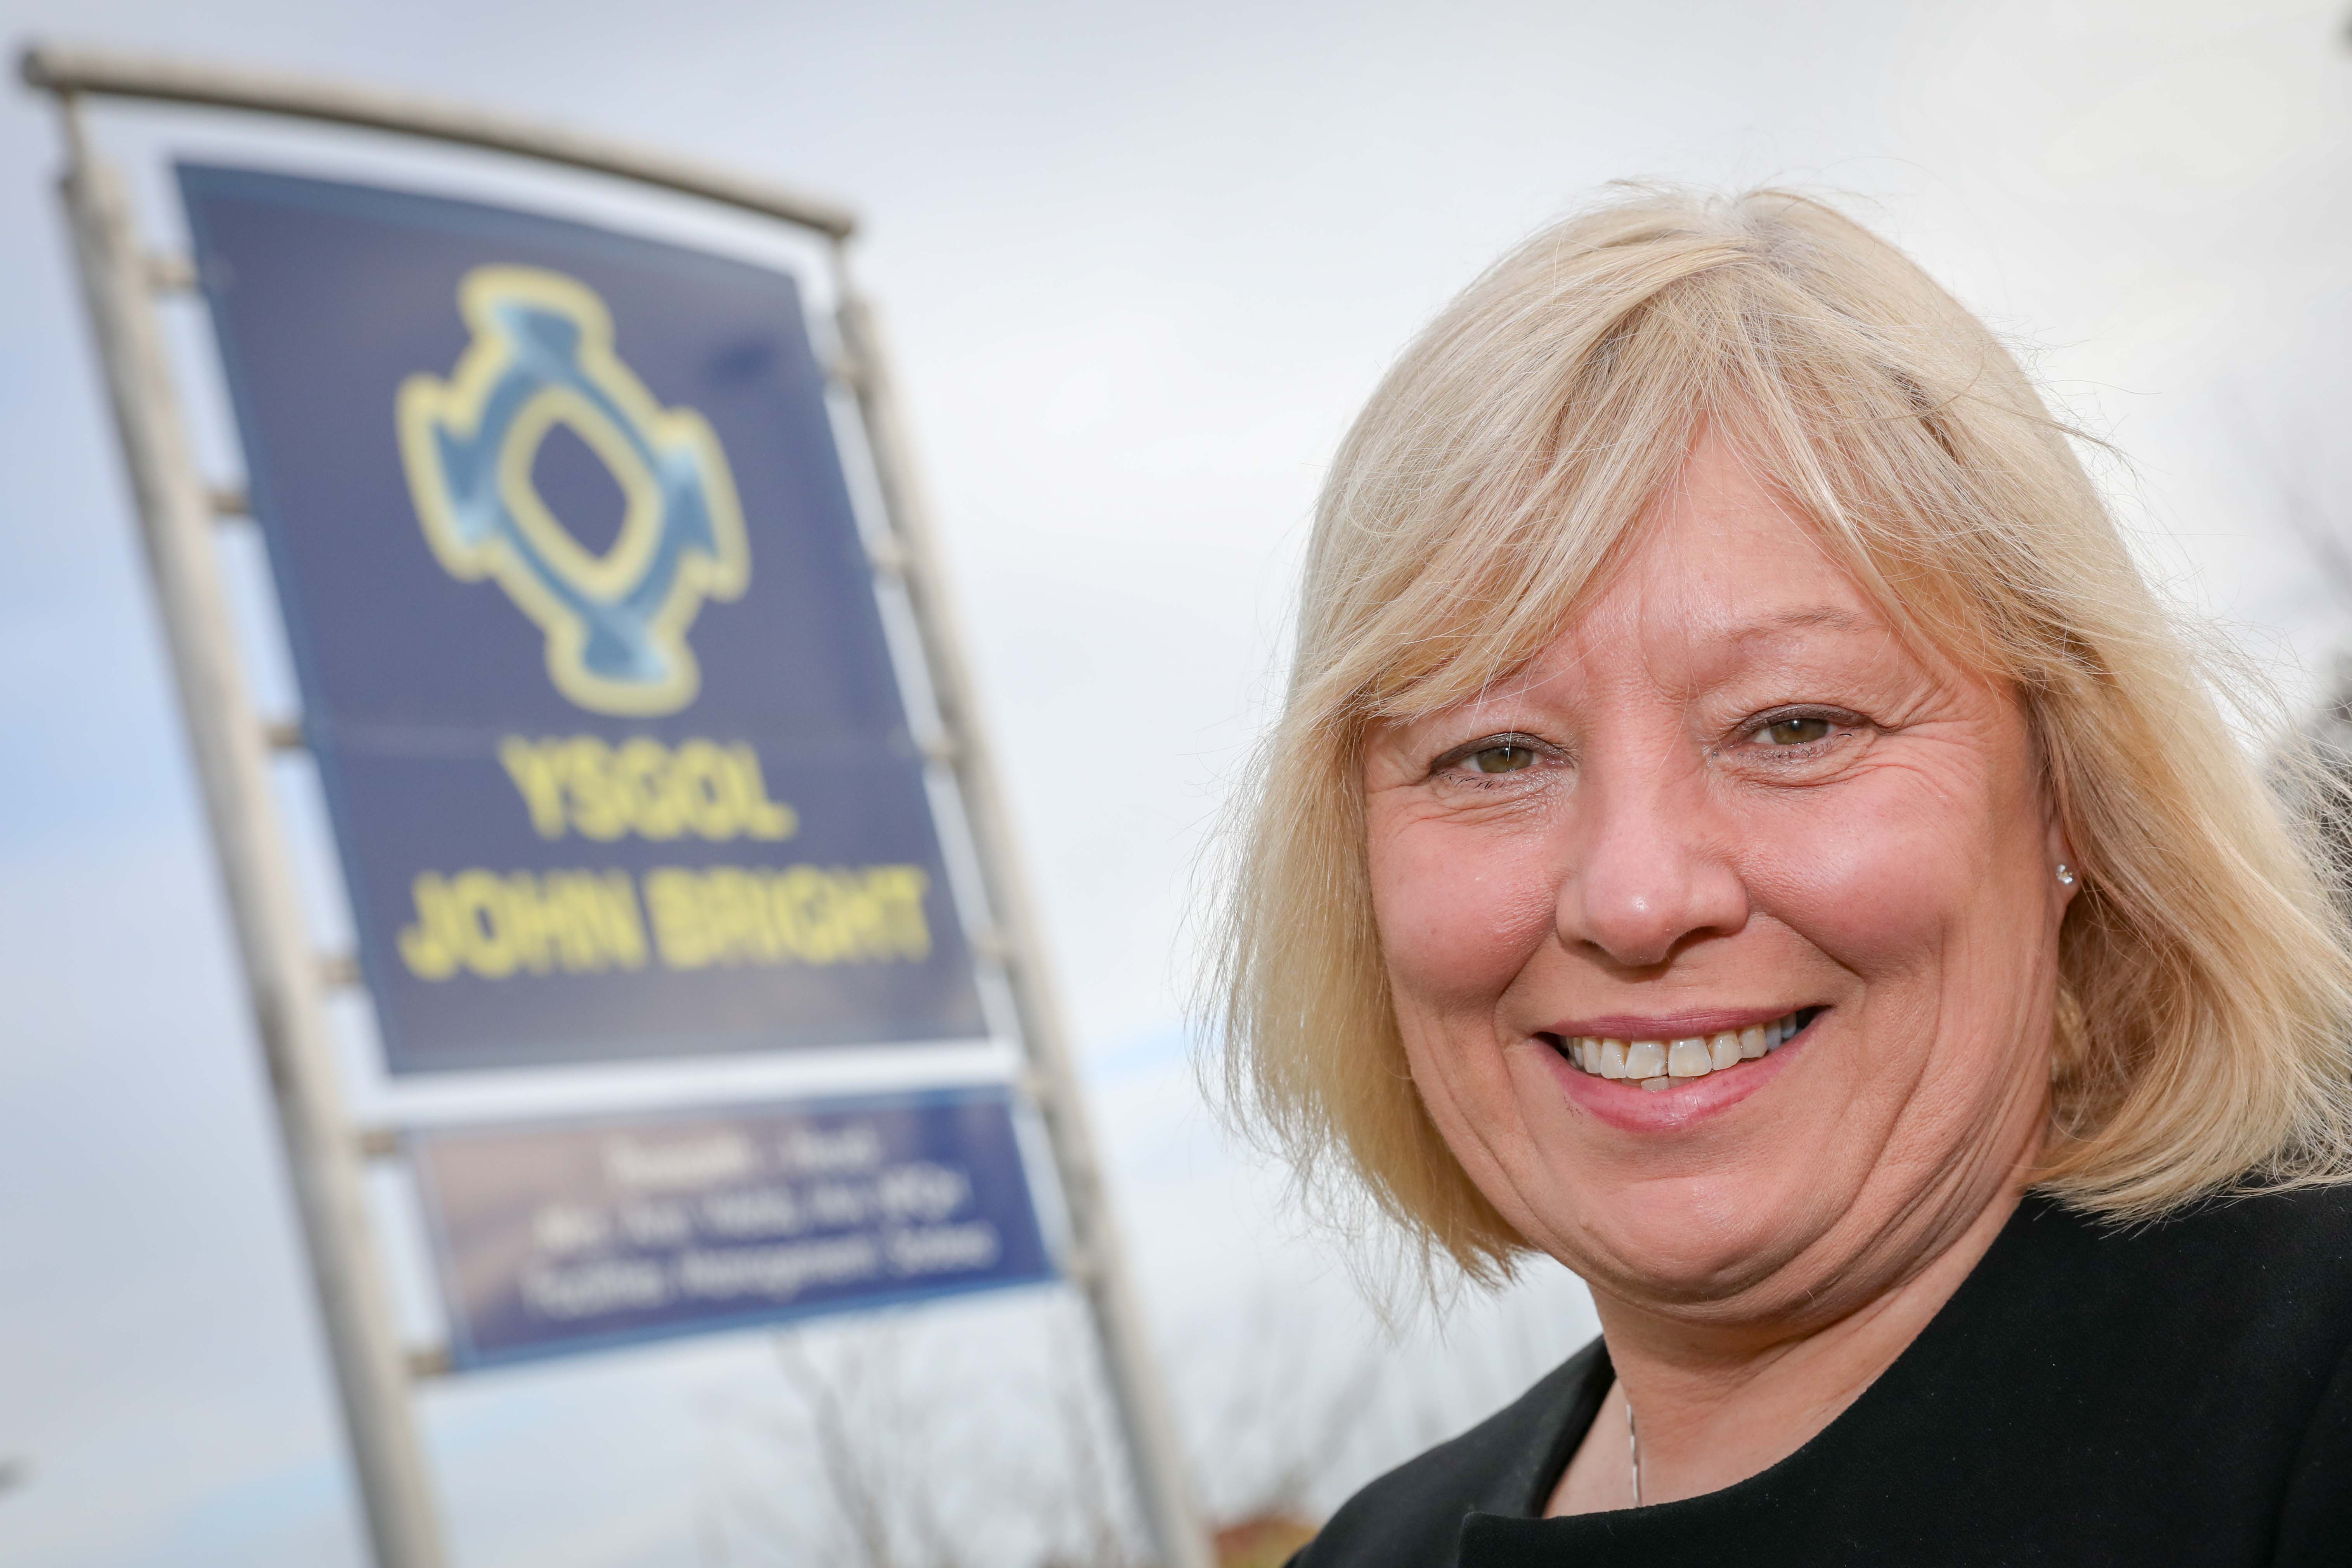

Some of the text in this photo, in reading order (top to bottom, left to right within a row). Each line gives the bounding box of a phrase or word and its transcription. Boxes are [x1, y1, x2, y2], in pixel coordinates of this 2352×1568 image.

[501, 738, 796, 838] YSGOL
[400, 866, 931, 978] JOHN BRIGHT
